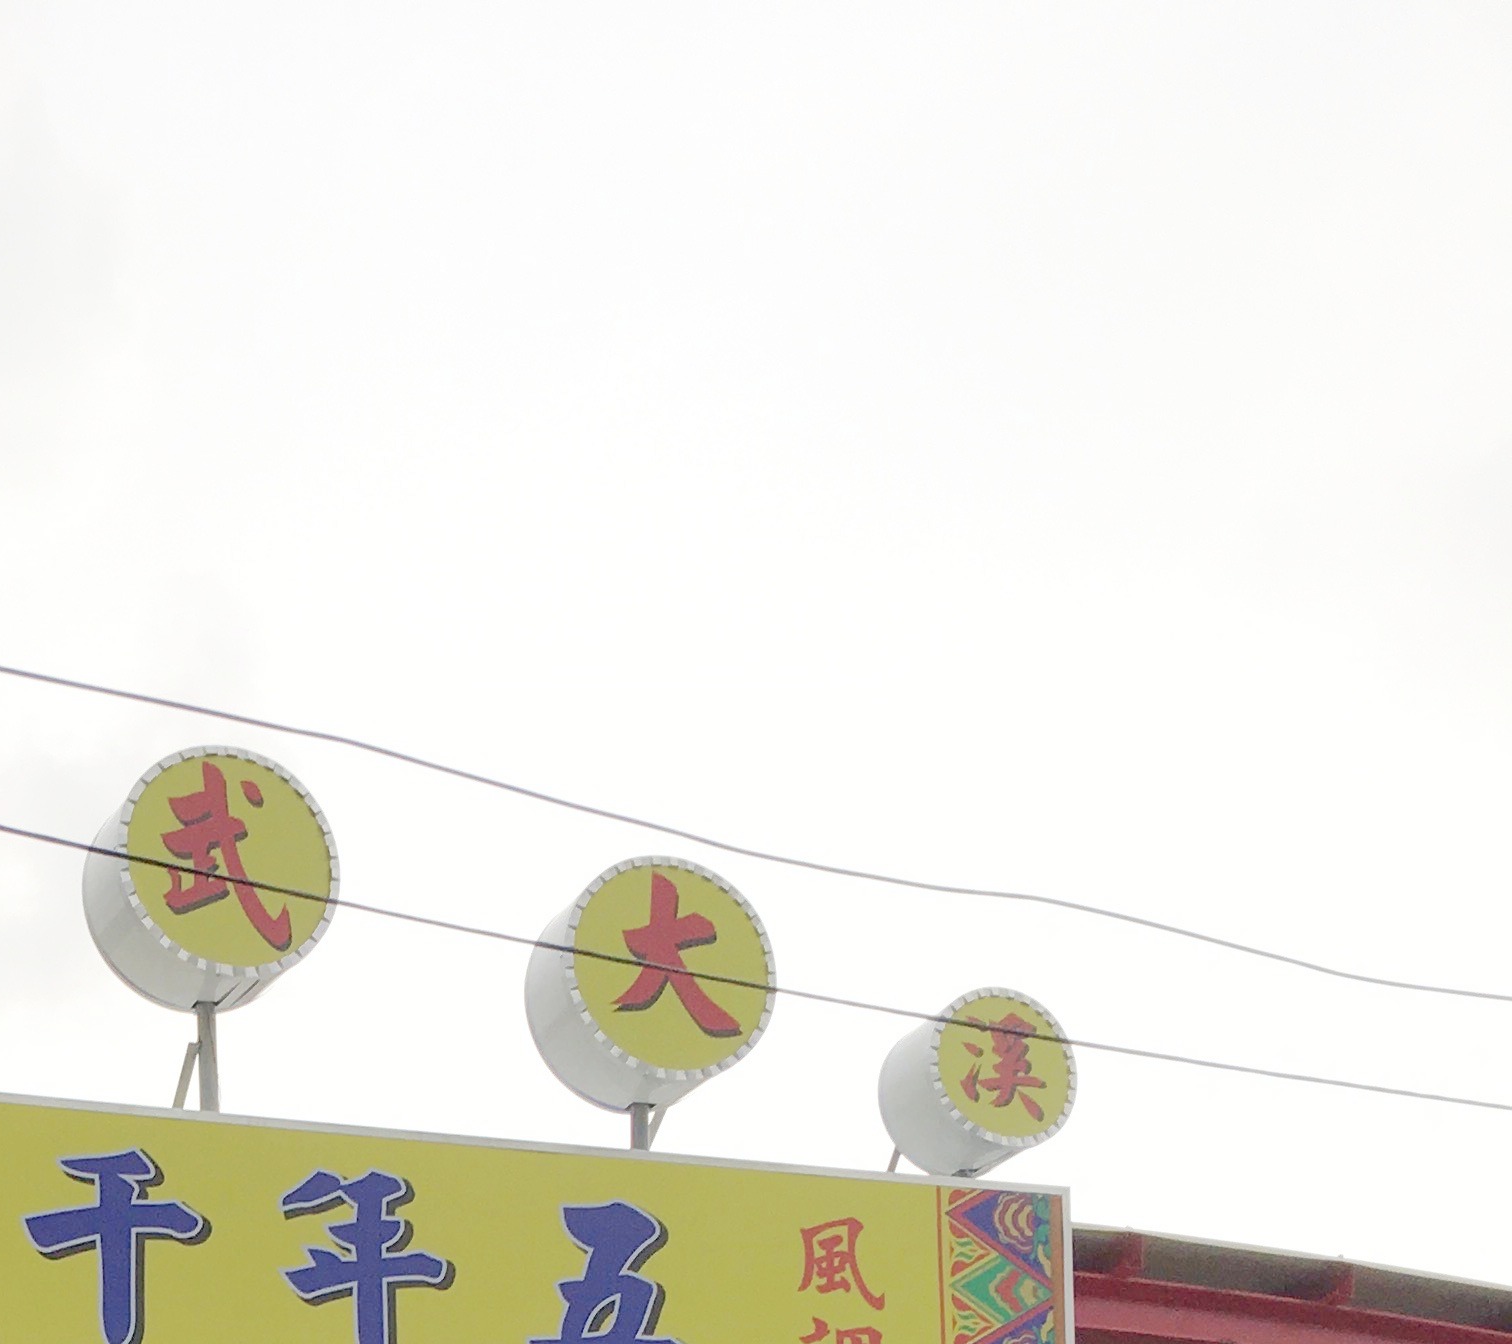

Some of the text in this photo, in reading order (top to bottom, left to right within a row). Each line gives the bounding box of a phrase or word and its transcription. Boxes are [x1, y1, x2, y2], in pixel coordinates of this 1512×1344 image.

[161, 761, 293, 952] 武
[613, 872, 742, 1037] 大
[959, 1013, 1047, 1122] 溪
